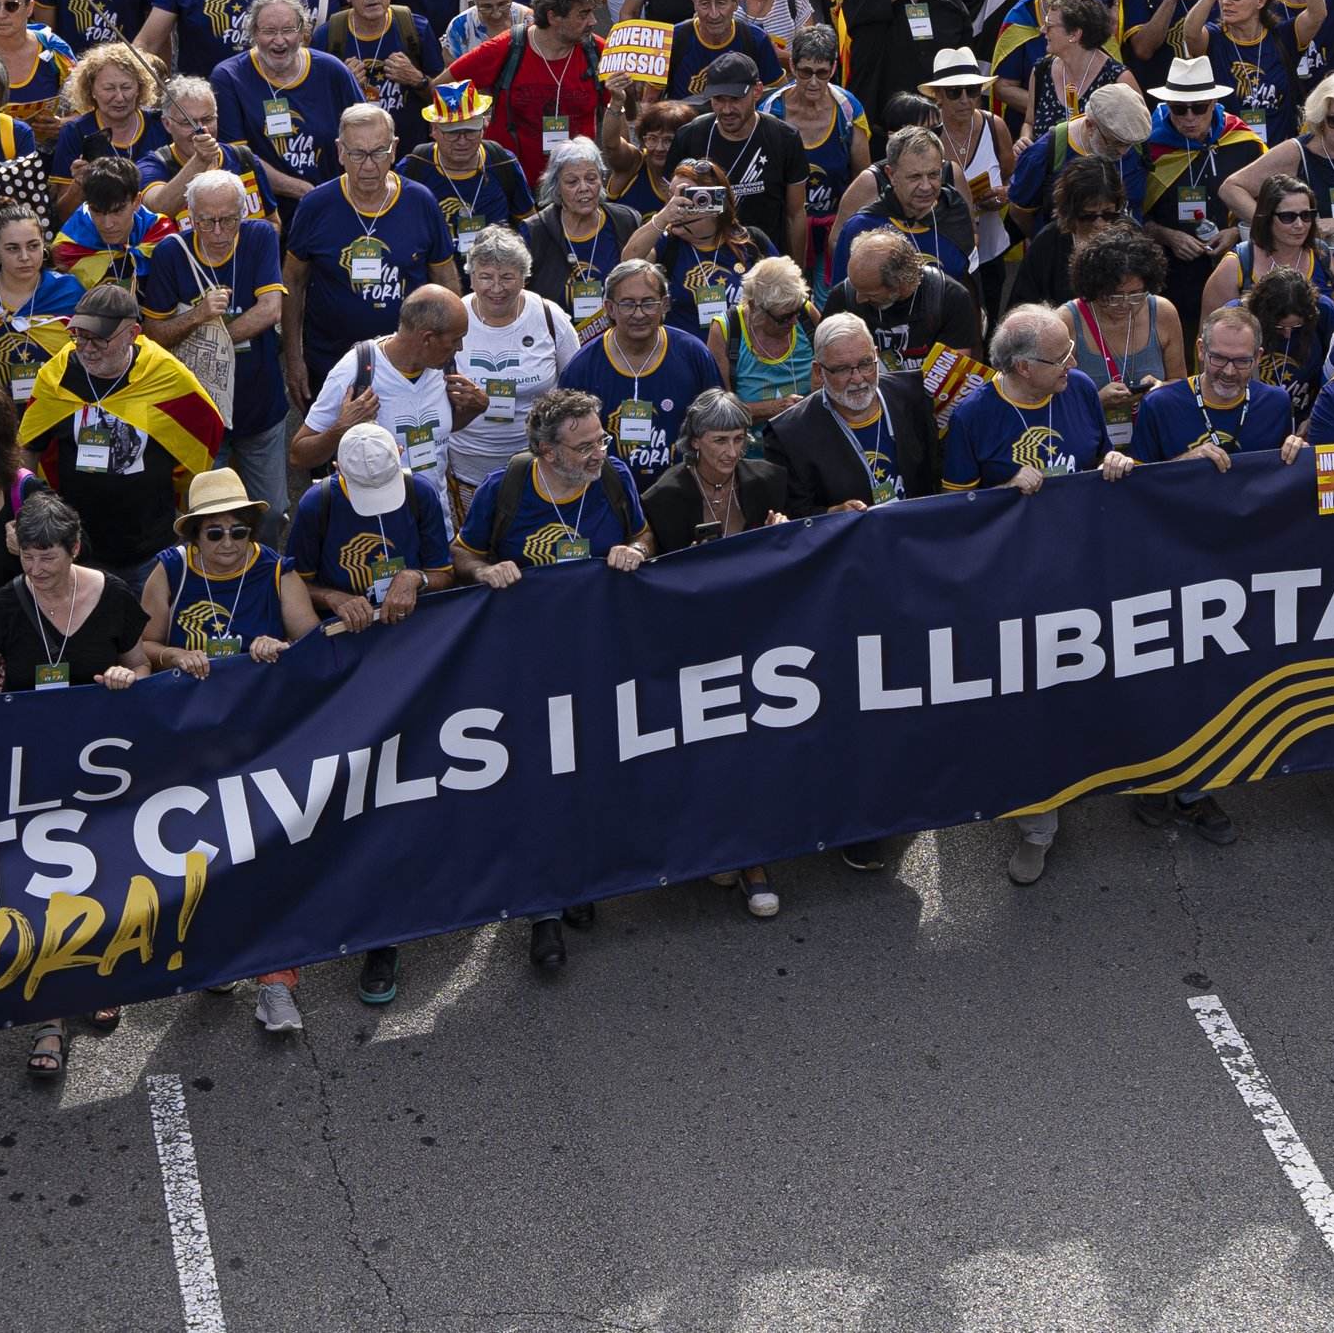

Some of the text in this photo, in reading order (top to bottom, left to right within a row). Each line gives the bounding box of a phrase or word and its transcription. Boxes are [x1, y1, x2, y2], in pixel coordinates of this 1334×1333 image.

[609, 26, 664, 48] GOVERN
[600, 49, 666, 76] DIMISSIÓ
[286, 132, 314, 151] VIA
[282, 149, 321, 169] FORA!
[134, 708, 508, 877] CIVILS
[547, 693, 577, 776] I
[617, 645, 820, 761] LES
